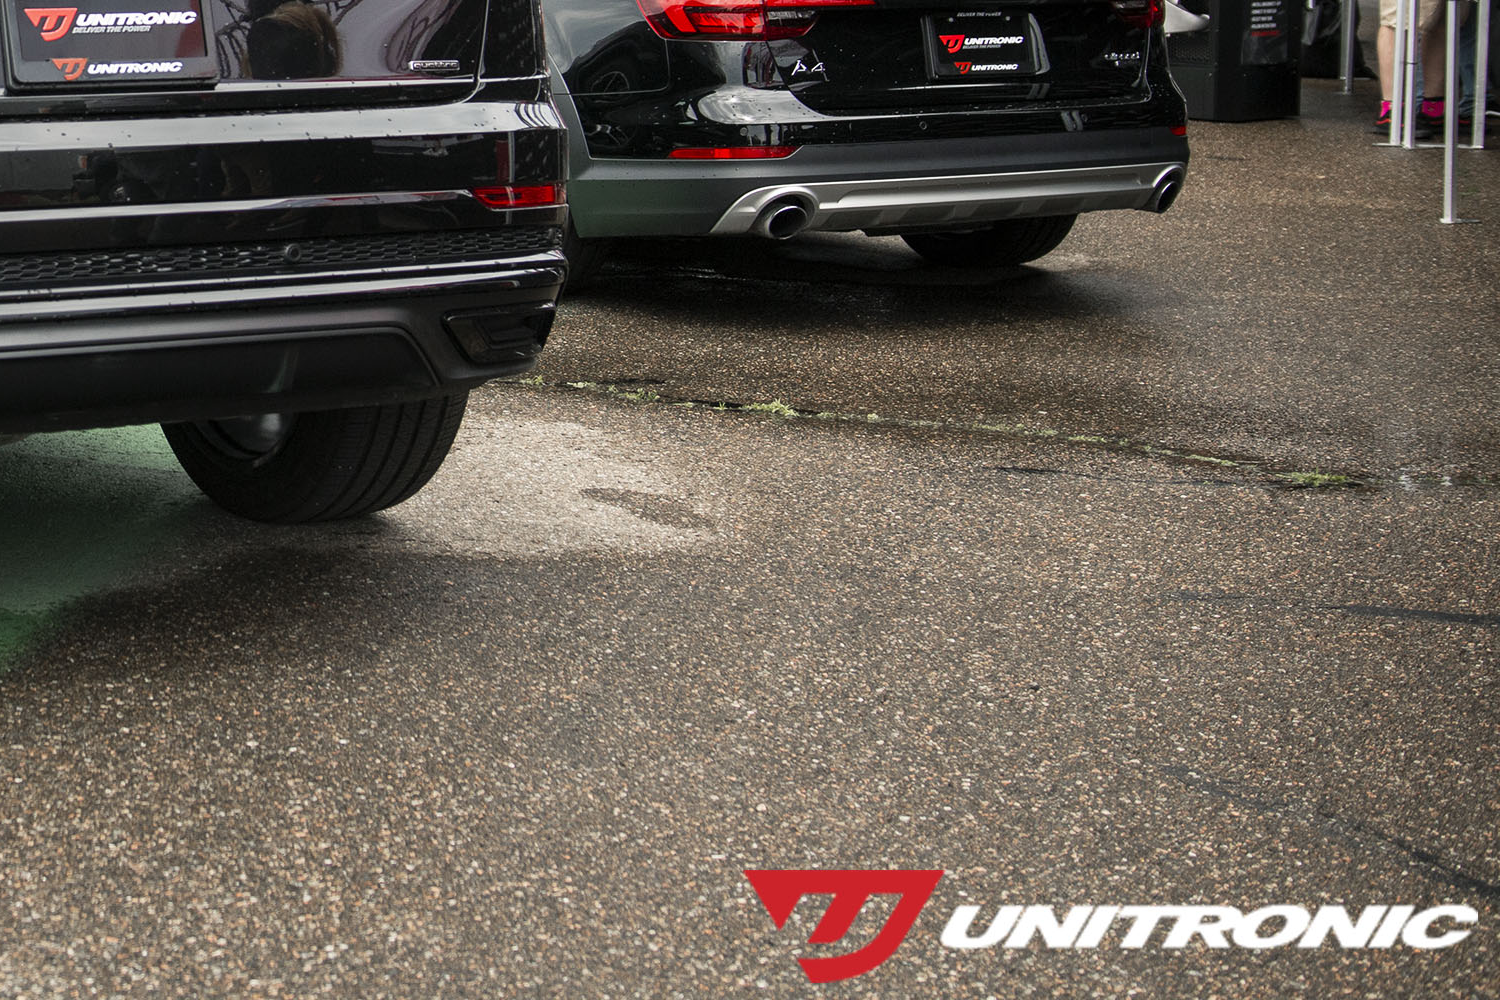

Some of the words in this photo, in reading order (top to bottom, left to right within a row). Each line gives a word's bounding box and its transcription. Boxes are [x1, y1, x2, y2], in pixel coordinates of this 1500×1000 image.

[75, 11, 197, 27] UNITRONIC
[71, 26, 107, 34] DELIVER
[122, 25, 152, 33] POWER
[963, 36, 1024, 46] UNITRONIC
[88, 61, 183, 75] UNITRONIC
[971, 63, 1019, 71] UNITRONIC
